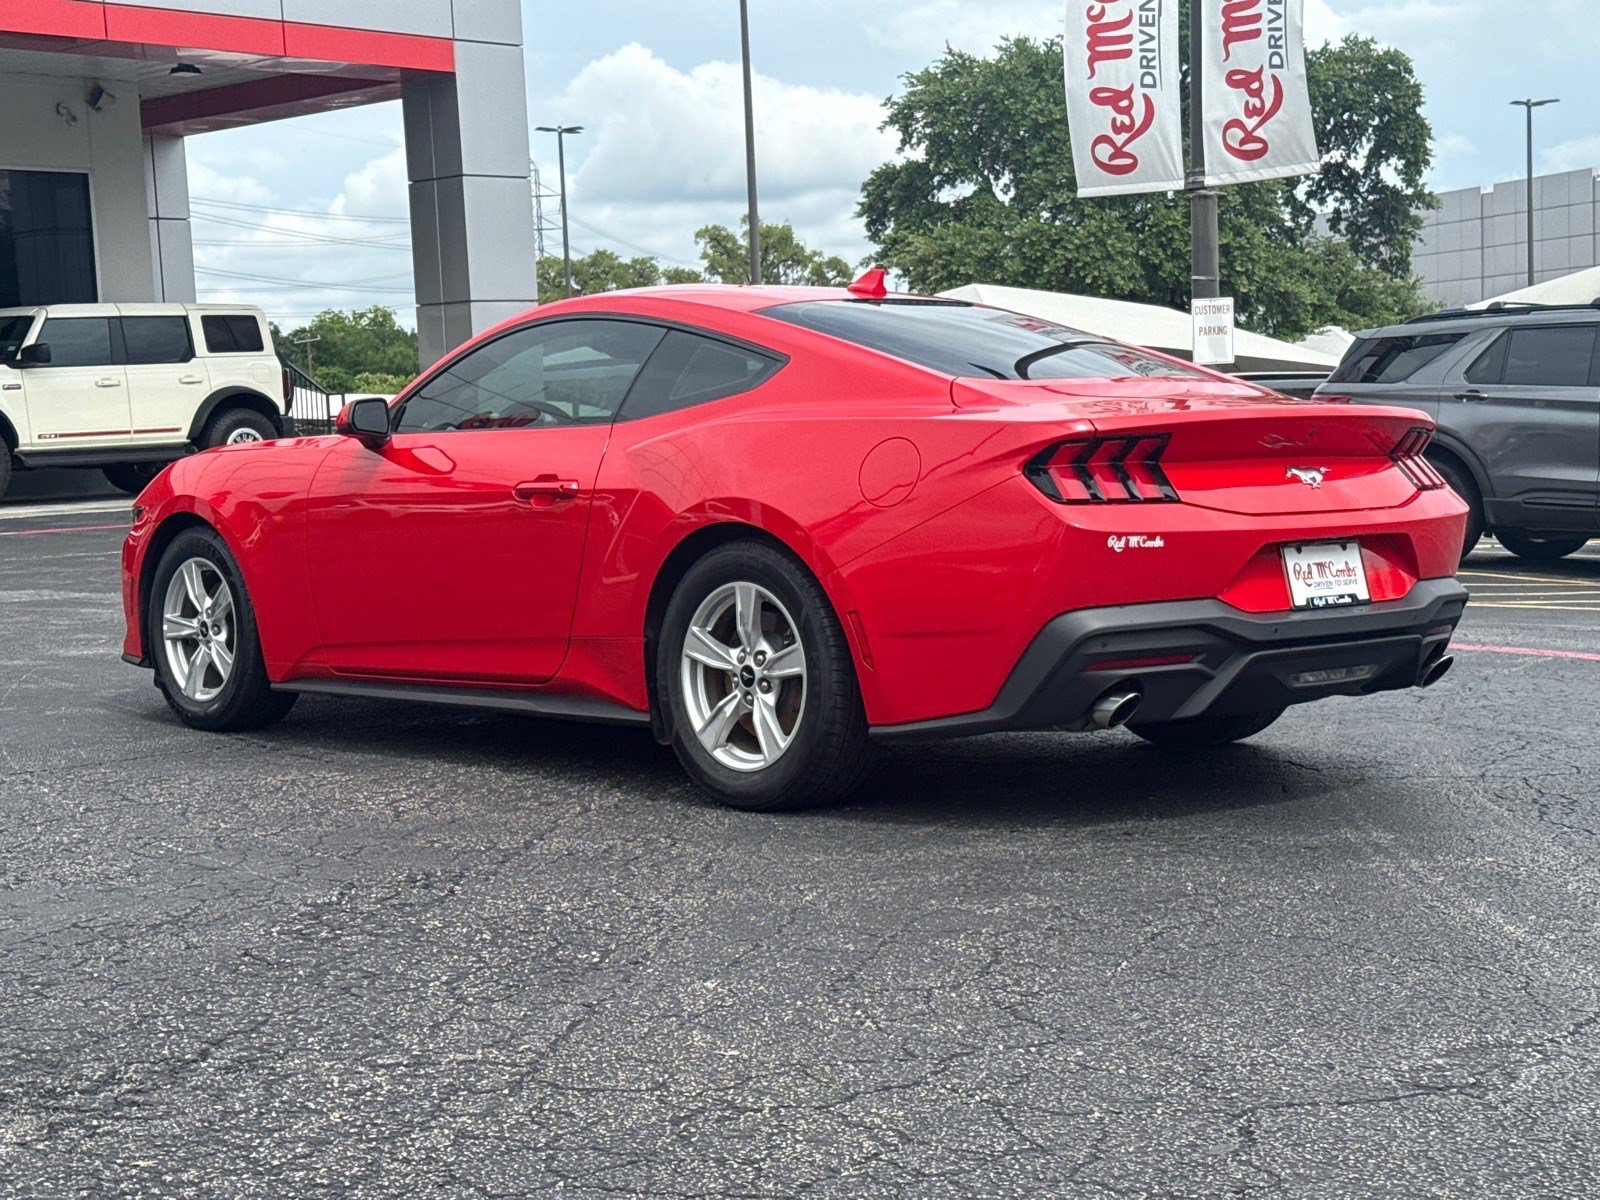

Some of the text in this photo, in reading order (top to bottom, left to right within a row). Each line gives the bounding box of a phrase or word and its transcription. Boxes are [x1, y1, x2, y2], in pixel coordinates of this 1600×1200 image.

[1139, 0, 1157, 89] DRIVEN
[1086, 0, 1155, 175] Red Mc
[1221, 0, 1283, 161] Red M
[1194, 304, 1231, 315] CUSTOMER
[1199, 326, 1228, 336] PARKING
[1107, 535, 1126, 552] Red
[1293, 560, 1357, 587] Red McCombs
[1313, 581, 1333, 589] DRIVEN
[1342, 578, 1358, 586] SERVE
